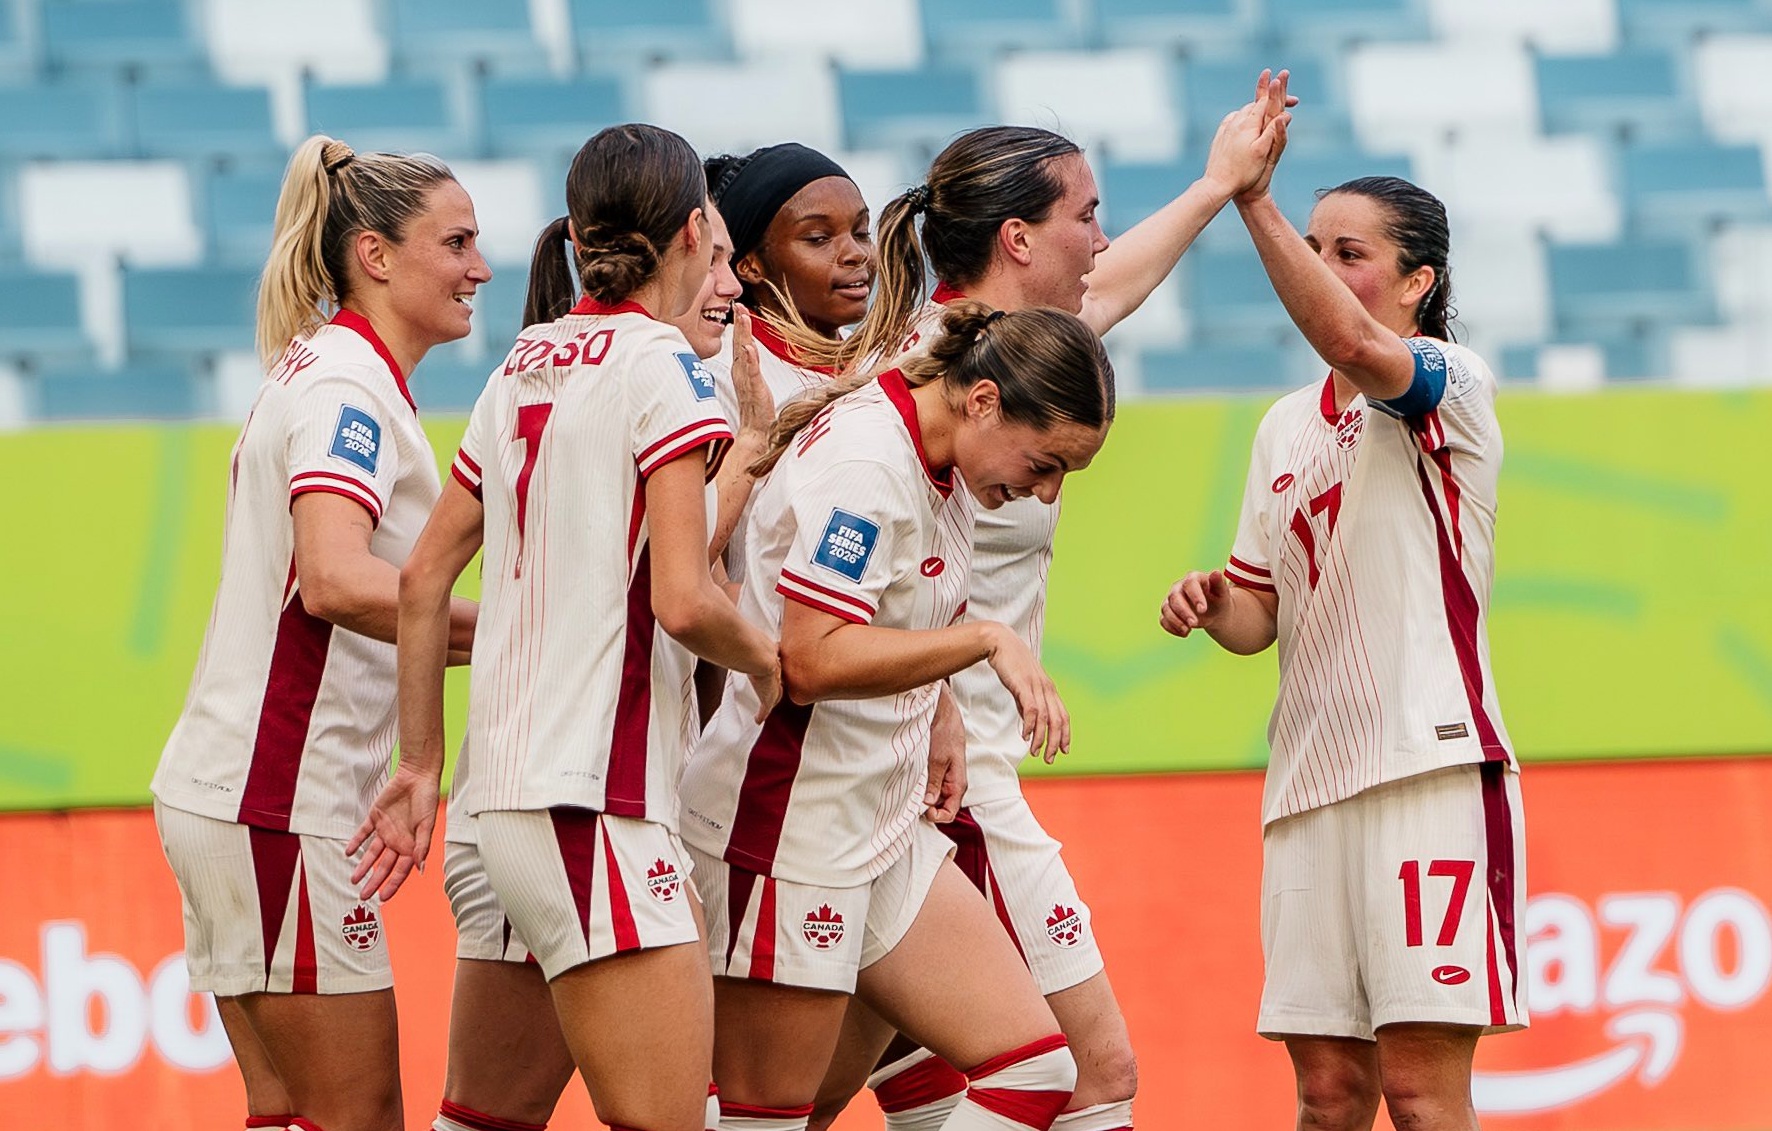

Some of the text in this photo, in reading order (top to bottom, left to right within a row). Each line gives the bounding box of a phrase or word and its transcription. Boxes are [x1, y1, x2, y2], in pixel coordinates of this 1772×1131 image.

[341, 427, 377, 452] SERIES
[350, 420, 373, 440] FIFA
[838, 525, 864, 544] FIFA
[827, 533, 867, 557] SERIES
[647, 874, 679, 887] CANADA
[1398, 860, 1475, 947] 17
[342, 922, 379, 934] CANADA
[803, 922, 844, 932] CANADA
[1046, 915, 1081, 936] CANADA
